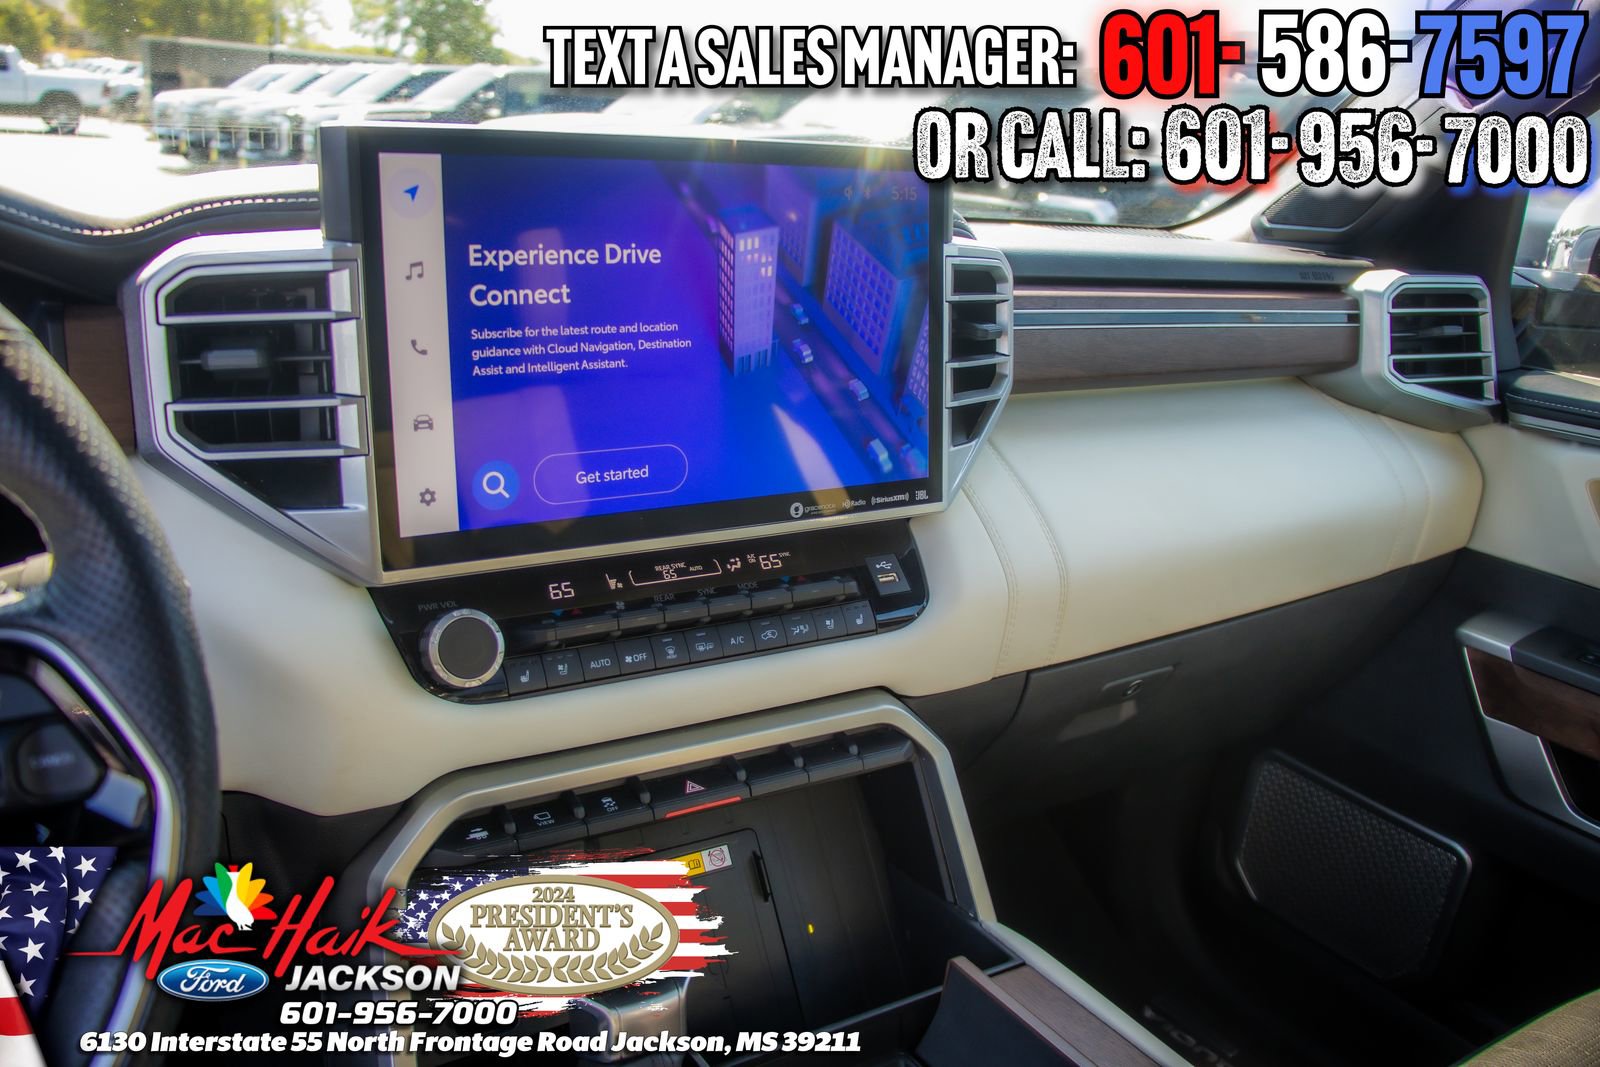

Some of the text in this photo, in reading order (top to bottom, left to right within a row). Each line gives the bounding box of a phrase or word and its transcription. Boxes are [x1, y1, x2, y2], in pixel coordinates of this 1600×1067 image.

[891, 186, 918, 201] 5:15
[468, 243, 662, 272] Experience Drive
[469, 283, 571, 307] Connect
[471, 321, 679, 340] Subscribe for the latest route and location
[472, 338, 692, 361] guidance with Cloud Navigation, Destination
[472, 358, 629, 376] Assist and Intelligent Assistant.
[576, 465, 649, 485] Get started
[915, 490, 929, 500] JBL
[654, 561, 687, 572] REAR SYNC
[759, 553, 783, 570] 65
[662, 569, 678, 580] 65
[549, 581, 575, 600] 65
[418, 600, 459, 612] PWR VOL
[730, 636, 745, 645] A/C
[590, 658, 611, 669] AUTO
[632, 652, 648, 663] OFF
[606, 805, 619, 813] OFF
[536, 818, 555, 827] VIEW
